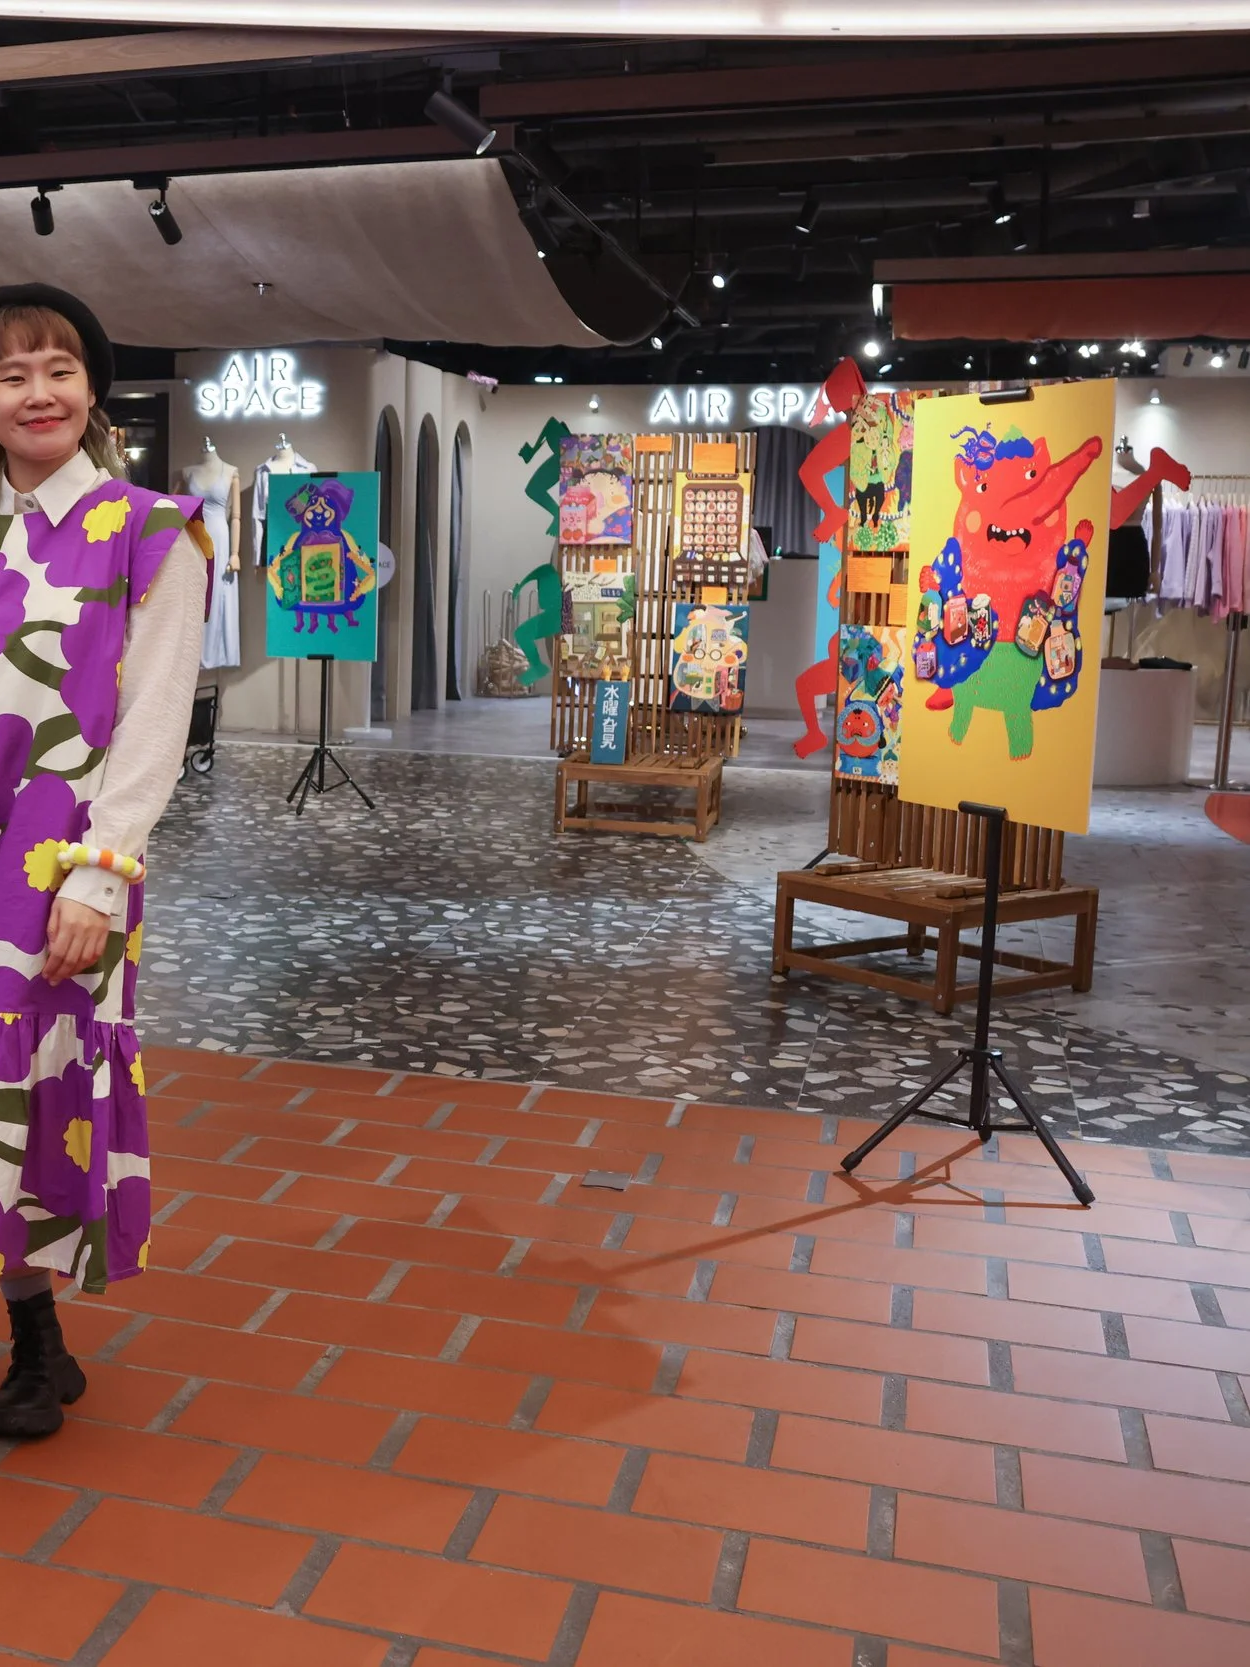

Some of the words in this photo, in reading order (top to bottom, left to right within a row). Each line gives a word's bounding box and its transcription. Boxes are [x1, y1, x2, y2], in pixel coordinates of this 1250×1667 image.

[222, 355, 289, 383] AIR
[199, 385, 318, 412] SPACE
[651, 390, 730, 420] AIR
